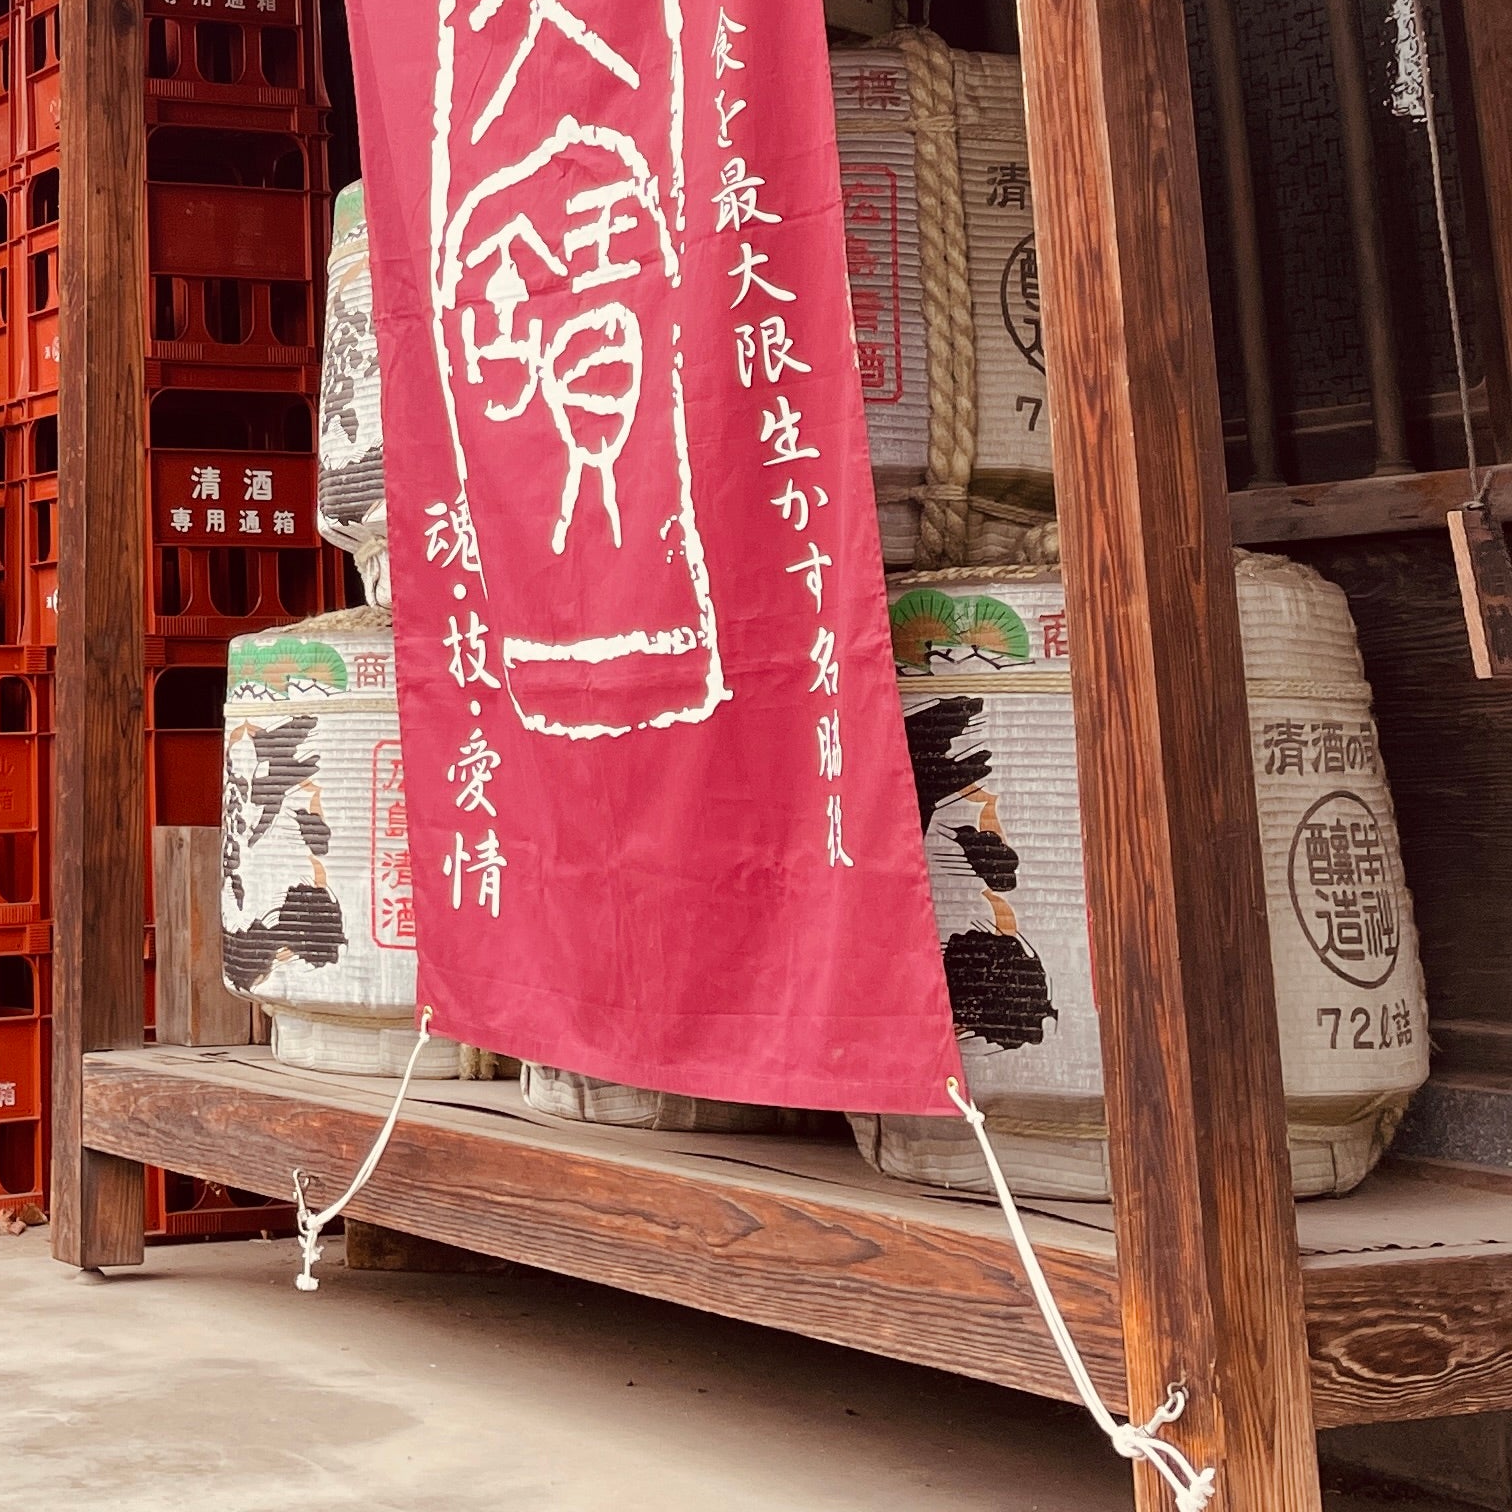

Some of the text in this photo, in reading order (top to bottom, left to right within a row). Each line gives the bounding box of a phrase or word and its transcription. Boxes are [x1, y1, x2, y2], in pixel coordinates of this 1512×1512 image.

[190, 467, 274, 501] 清酒
[170, 507, 296, 536] 専用通箱
